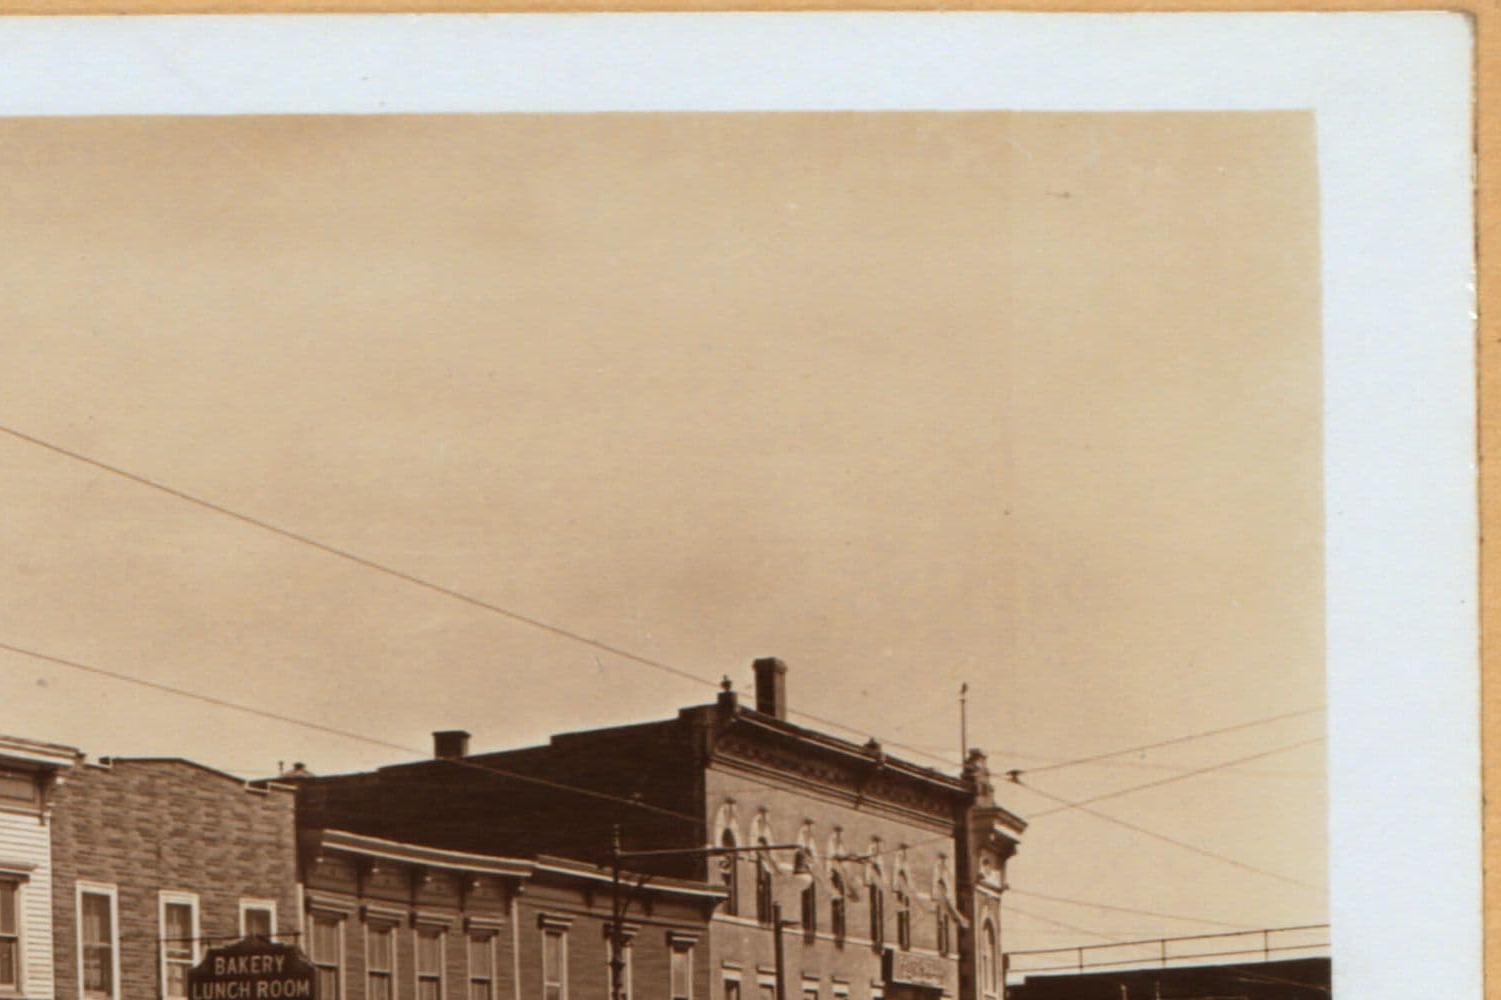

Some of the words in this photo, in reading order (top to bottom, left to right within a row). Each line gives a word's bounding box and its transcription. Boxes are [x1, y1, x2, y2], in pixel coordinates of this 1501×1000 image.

[215, 955, 285, 975] BAKERY
[193, 981, 250, 1000] LUNCH
[257, 980, 310, 998] ROOM
